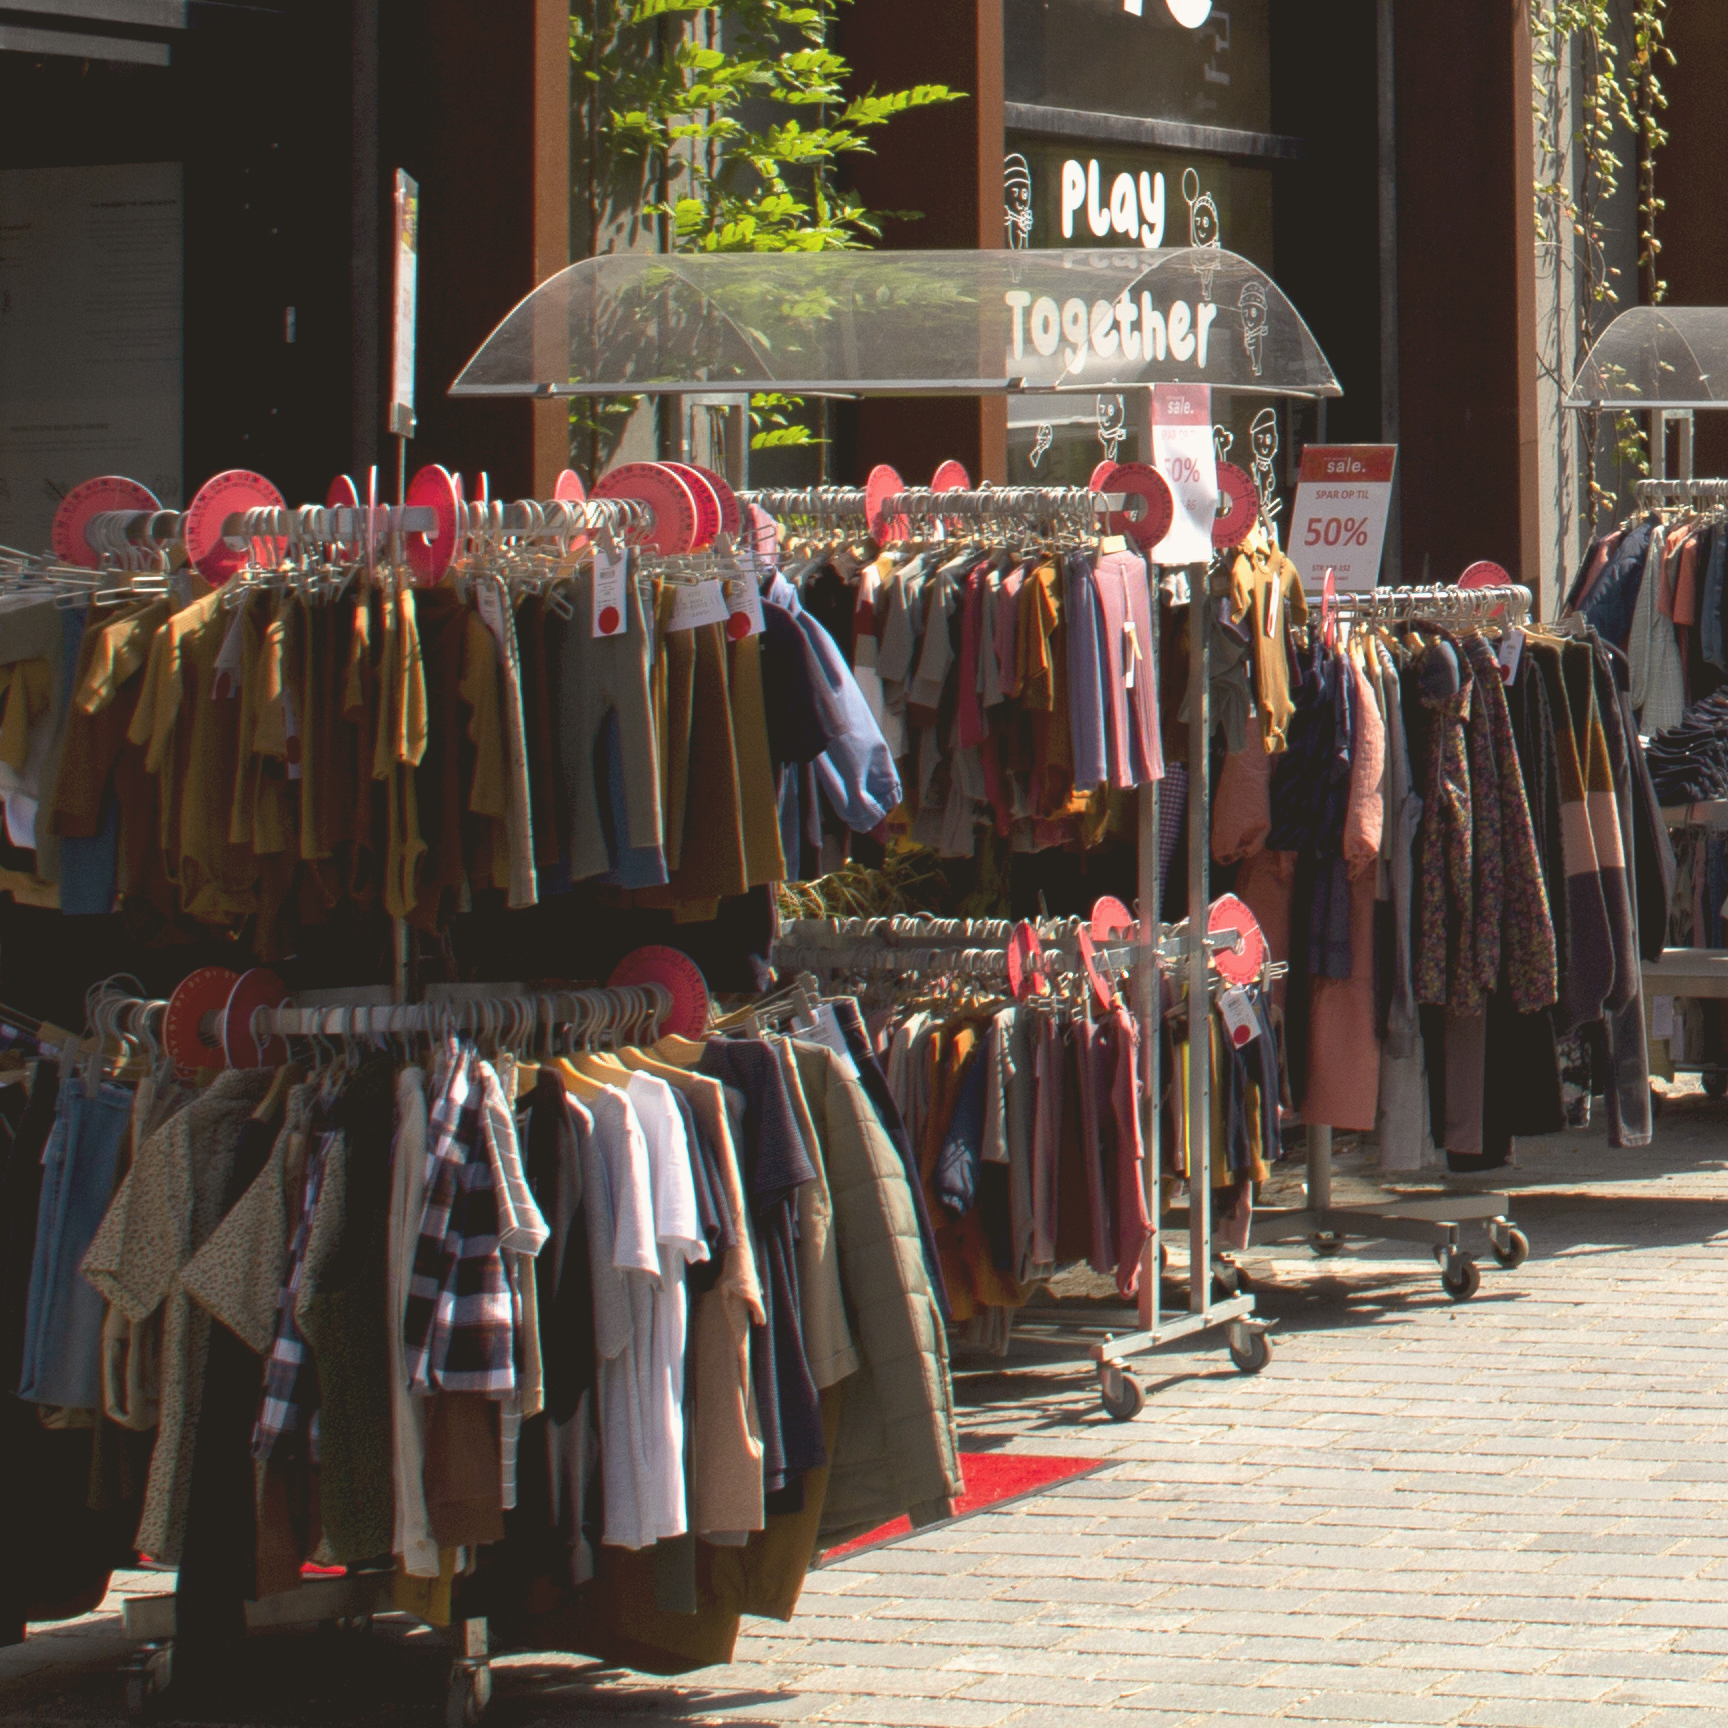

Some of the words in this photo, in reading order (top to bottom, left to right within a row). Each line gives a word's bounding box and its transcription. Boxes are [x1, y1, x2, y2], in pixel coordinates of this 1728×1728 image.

[1061, 159, 1166, 249] Play
[1004, 289, 1218, 375] Together
[1327, 456, 1367, 474] sale.
[1316, 490, 1339, 500] SPAR
[1341, 489, 1355, 500] OP
[1304, 516, 1369, 547] 50%
